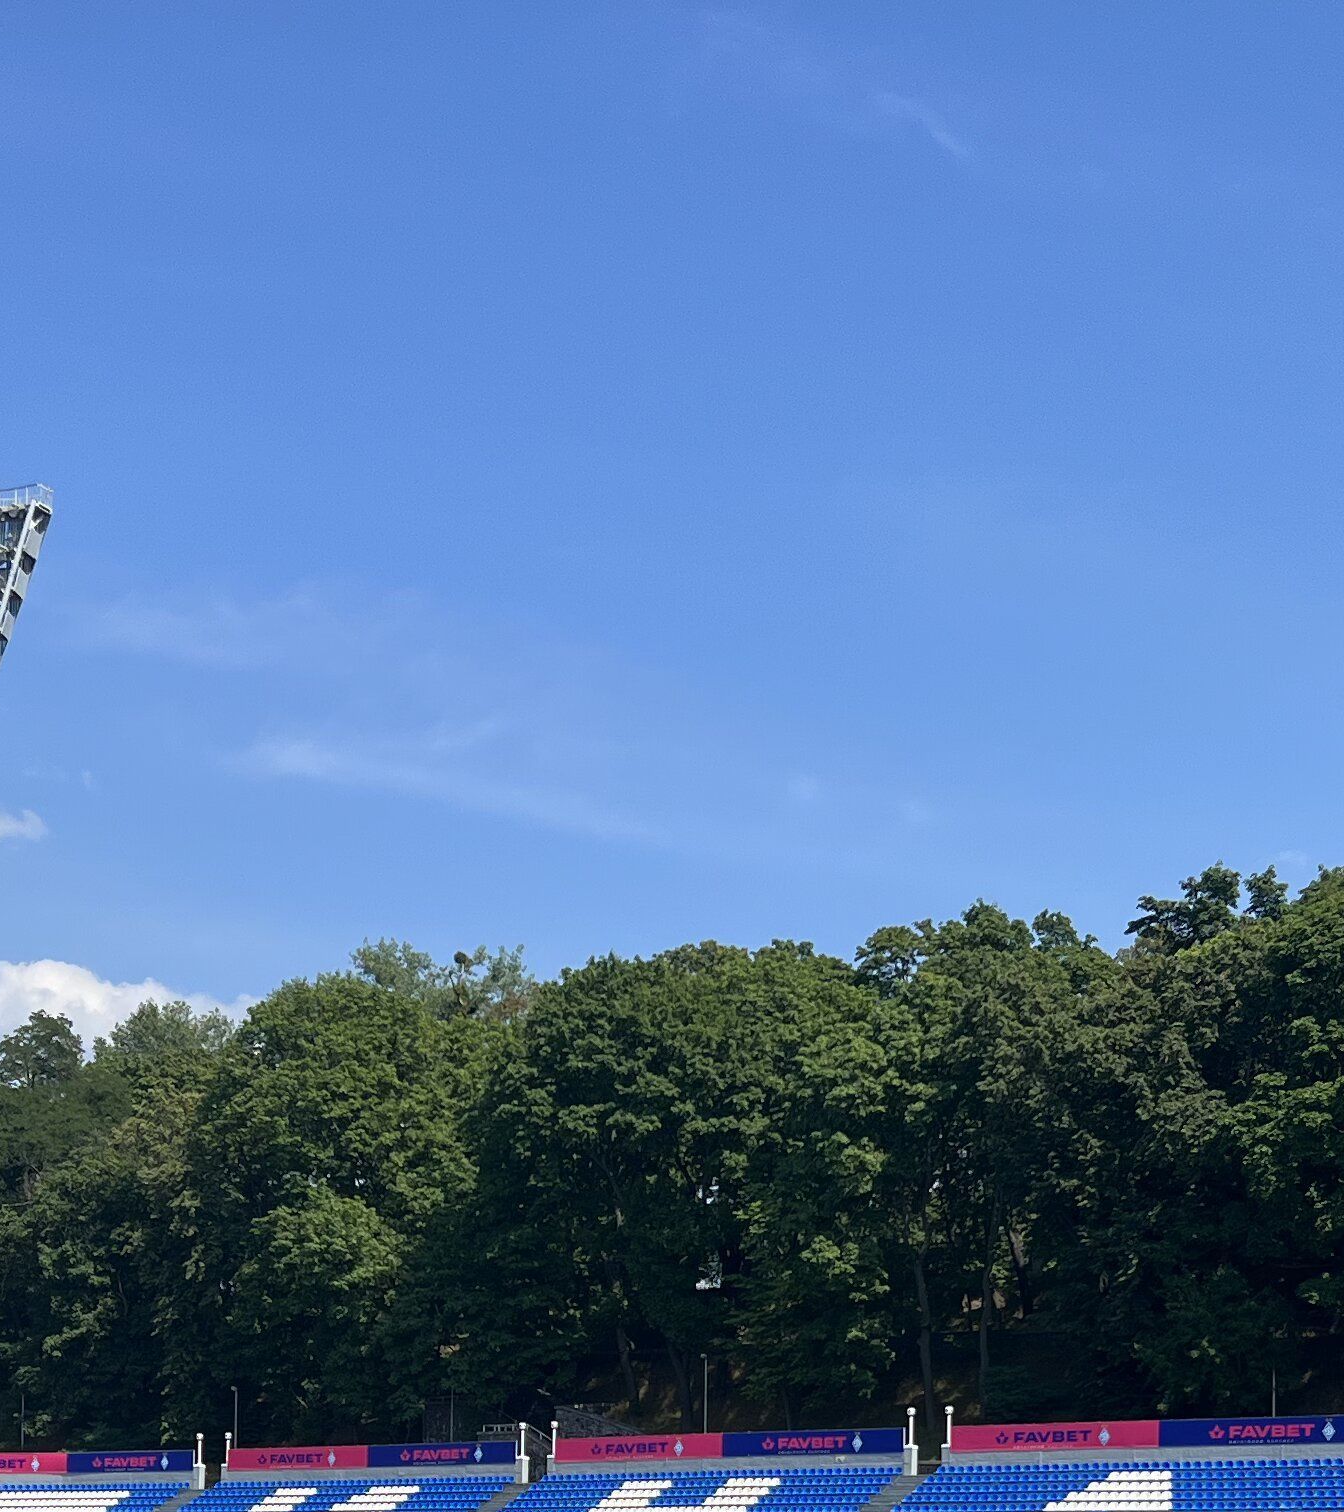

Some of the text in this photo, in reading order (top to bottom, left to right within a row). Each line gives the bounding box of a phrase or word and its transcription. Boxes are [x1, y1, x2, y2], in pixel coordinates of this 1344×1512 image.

[1013, 1429, 1092, 1444] FAVBET
[1228, 1423, 1316, 1439] FAVBET
[605, 1442, 669, 1455] FAVBET
[777, 1436, 847, 1450] FAVBET
[269, 1453, 323, 1465] FAVBET
[413, 1448, 470, 1461] FAVBET
[103, 1456, 157, 1467] FAVBET
